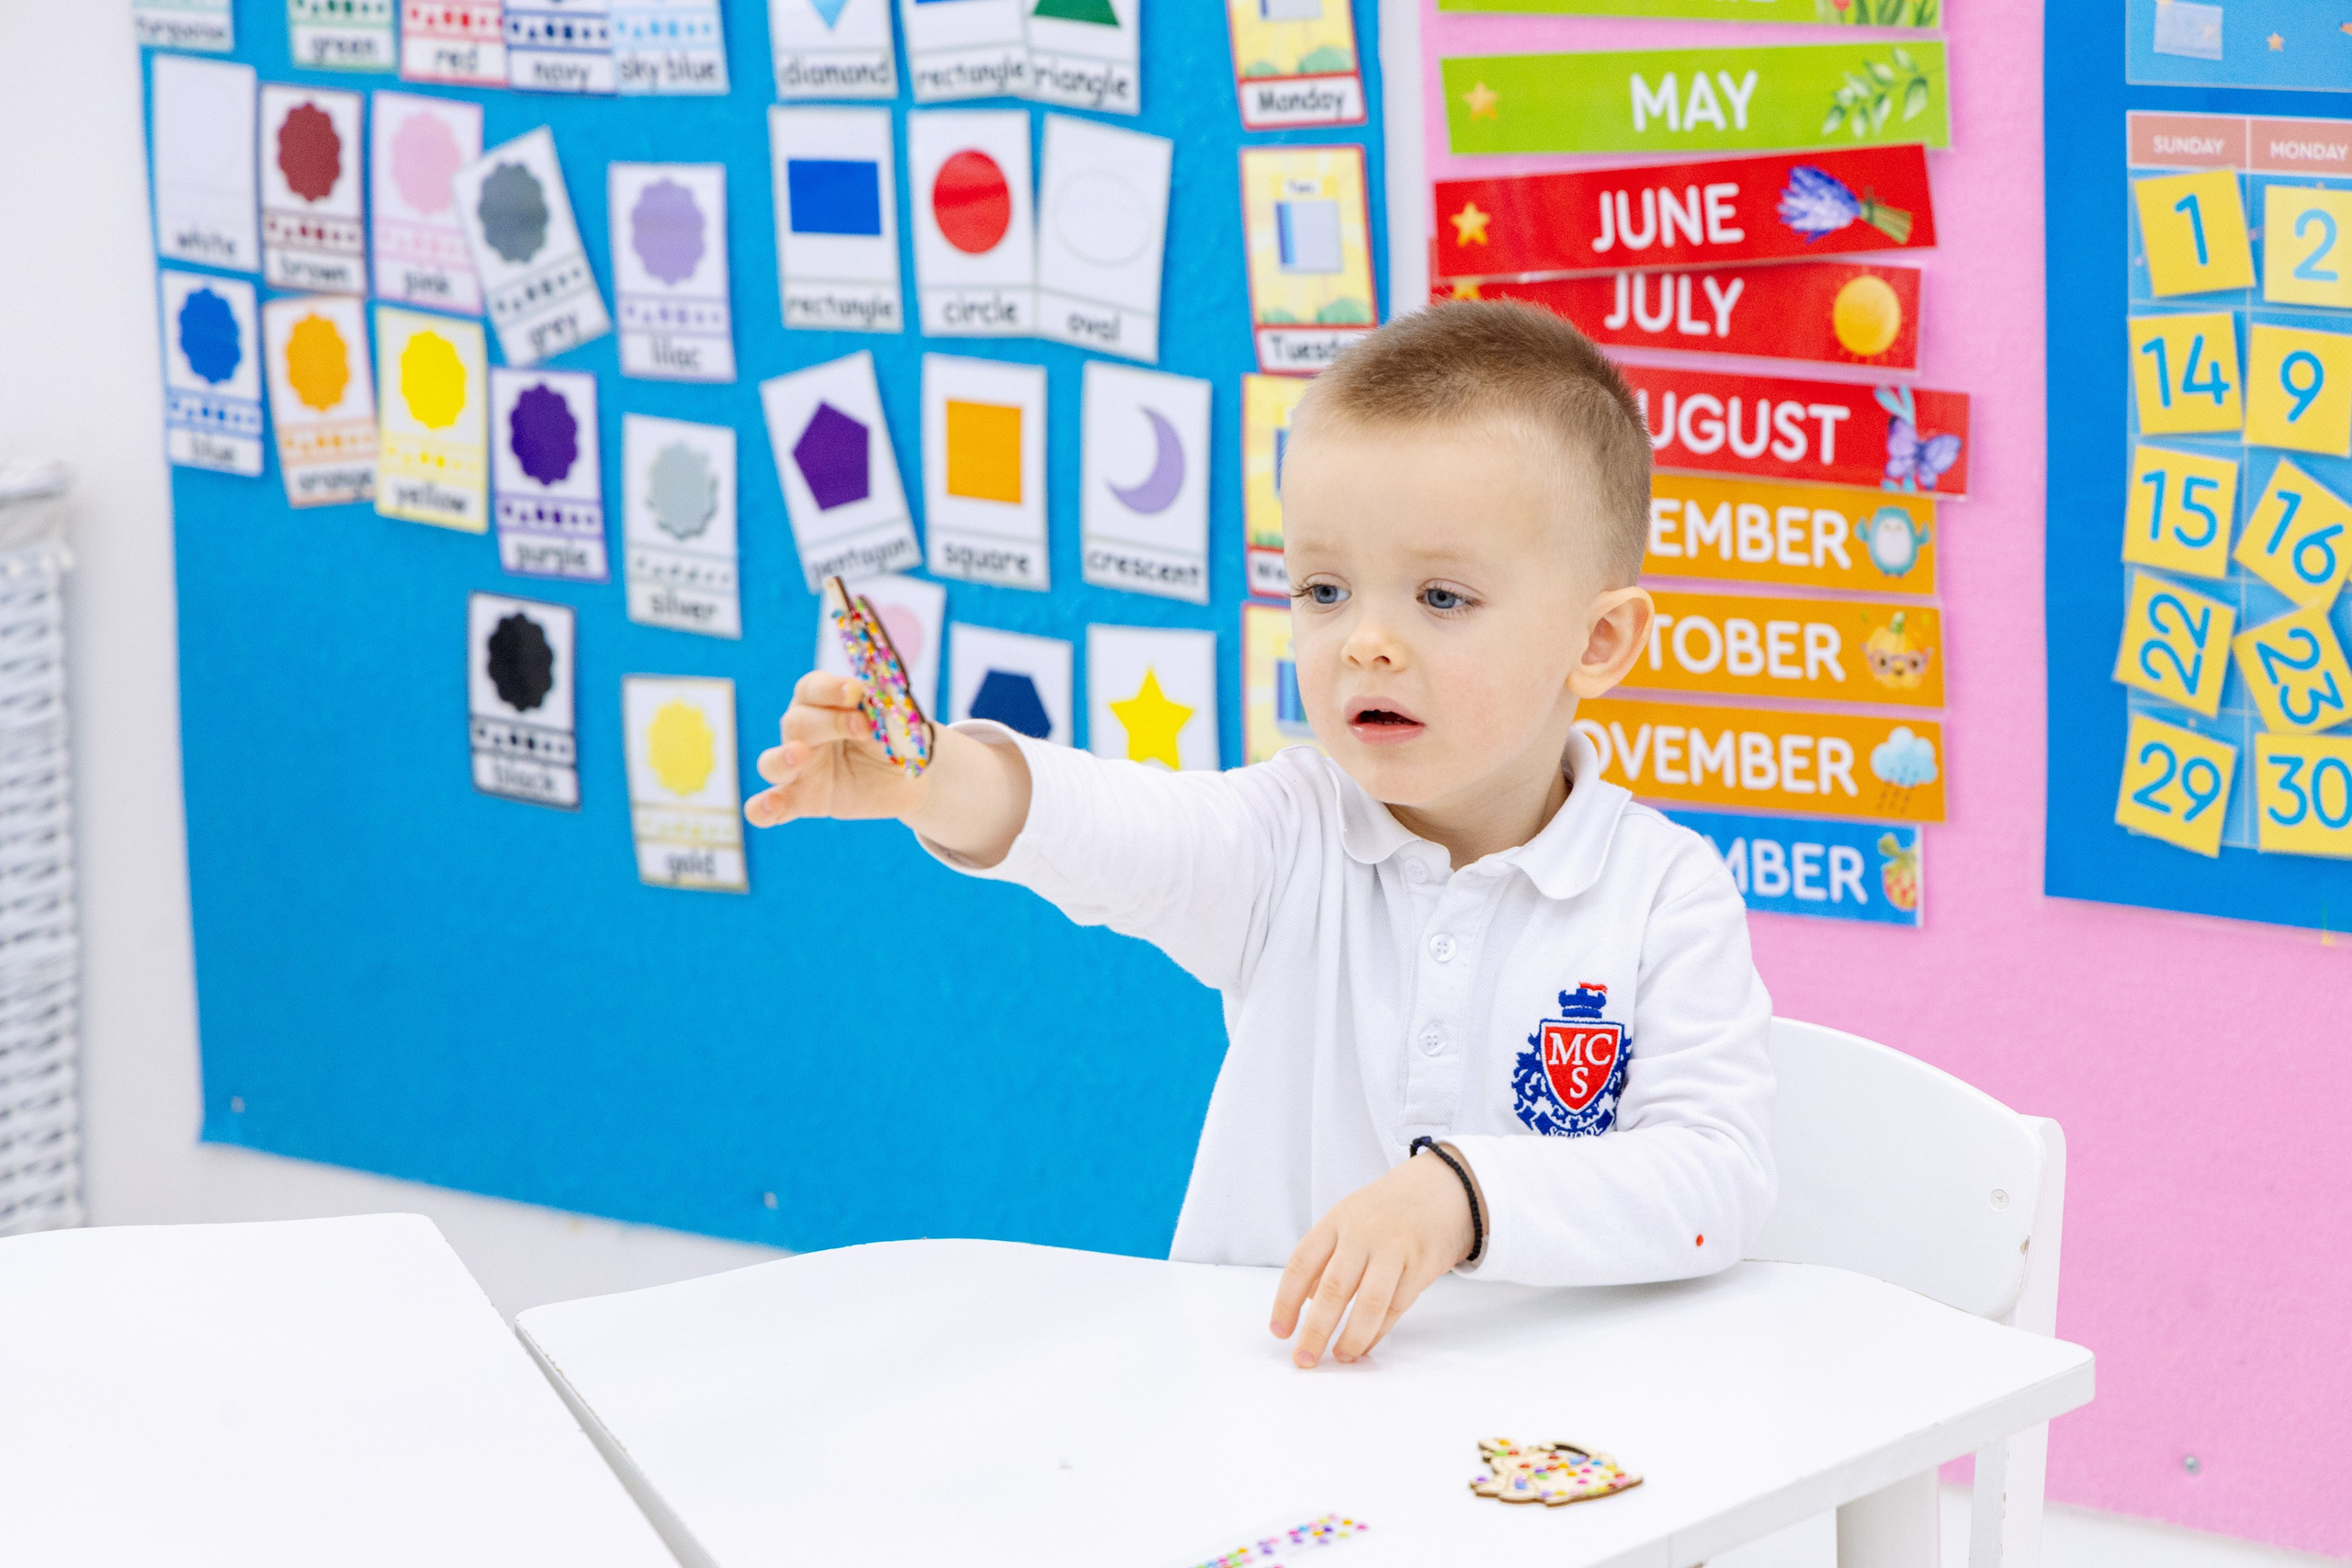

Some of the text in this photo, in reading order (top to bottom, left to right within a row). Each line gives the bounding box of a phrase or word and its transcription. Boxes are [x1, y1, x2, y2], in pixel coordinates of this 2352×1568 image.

[311, 37, 376, 65] green
[435, 43, 479, 73] red
[620, 49, 716, 91] sky blue
[786, 53, 891, 87] diamond
[533, 60, 591, 91] navy
[920, 55, 1023, 93] rectangle
[1032, 59, 1130, 107] riangle
[1258, 85, 1344, 121] Monday
[1629, 70, 1758, 133] MAY
[2153, 135, 2225, 155] SUNDAY
[2269, 141, 2348, 161] MONDAY
[1592, 182, 1745, 253] JUNE
[2174, 193, 2209, 266] 1
[2292, 208, 2339, 283] 2
[786, 292, 892, 330] rectangle
[942, 288, 1019, 324] circle
[1603, 269, 1745, 337] JULY
[1067, 309, 1122, 343] oval
[1270, 334, 1341, 361] Tuesd
[650, 332, 703, 367] lilac
[2141, 333, 2232, 409] 14
[2279, 349, 2325, 423] 9
[1637, 389, 1851, 466] UGUST
[2142, 468, 2219, 549] 15
[1649, 497, 1853, 570] EMBER
[2266, 488, 2345, 585] 16
[943, 545, 1033, 579] square
[1086, 550, 1201, 586] crescent
[650, 587, 717, 620] silver
[1648, 613, 1847, 682] TOBER
[2139, 592, 2211, 697] 22
[2256, 626, 2345, 726] 23
[1572, 719, 1860, 797] OVEMBER
[2131, 739, 2222, 823] 29
[2267, 753, 2352, 831] 30
[1704, 834, 1869, 905] MBER
[1547, 1031, 1613, 1066] MC
[1569, 1066, 1589, 1100] S
